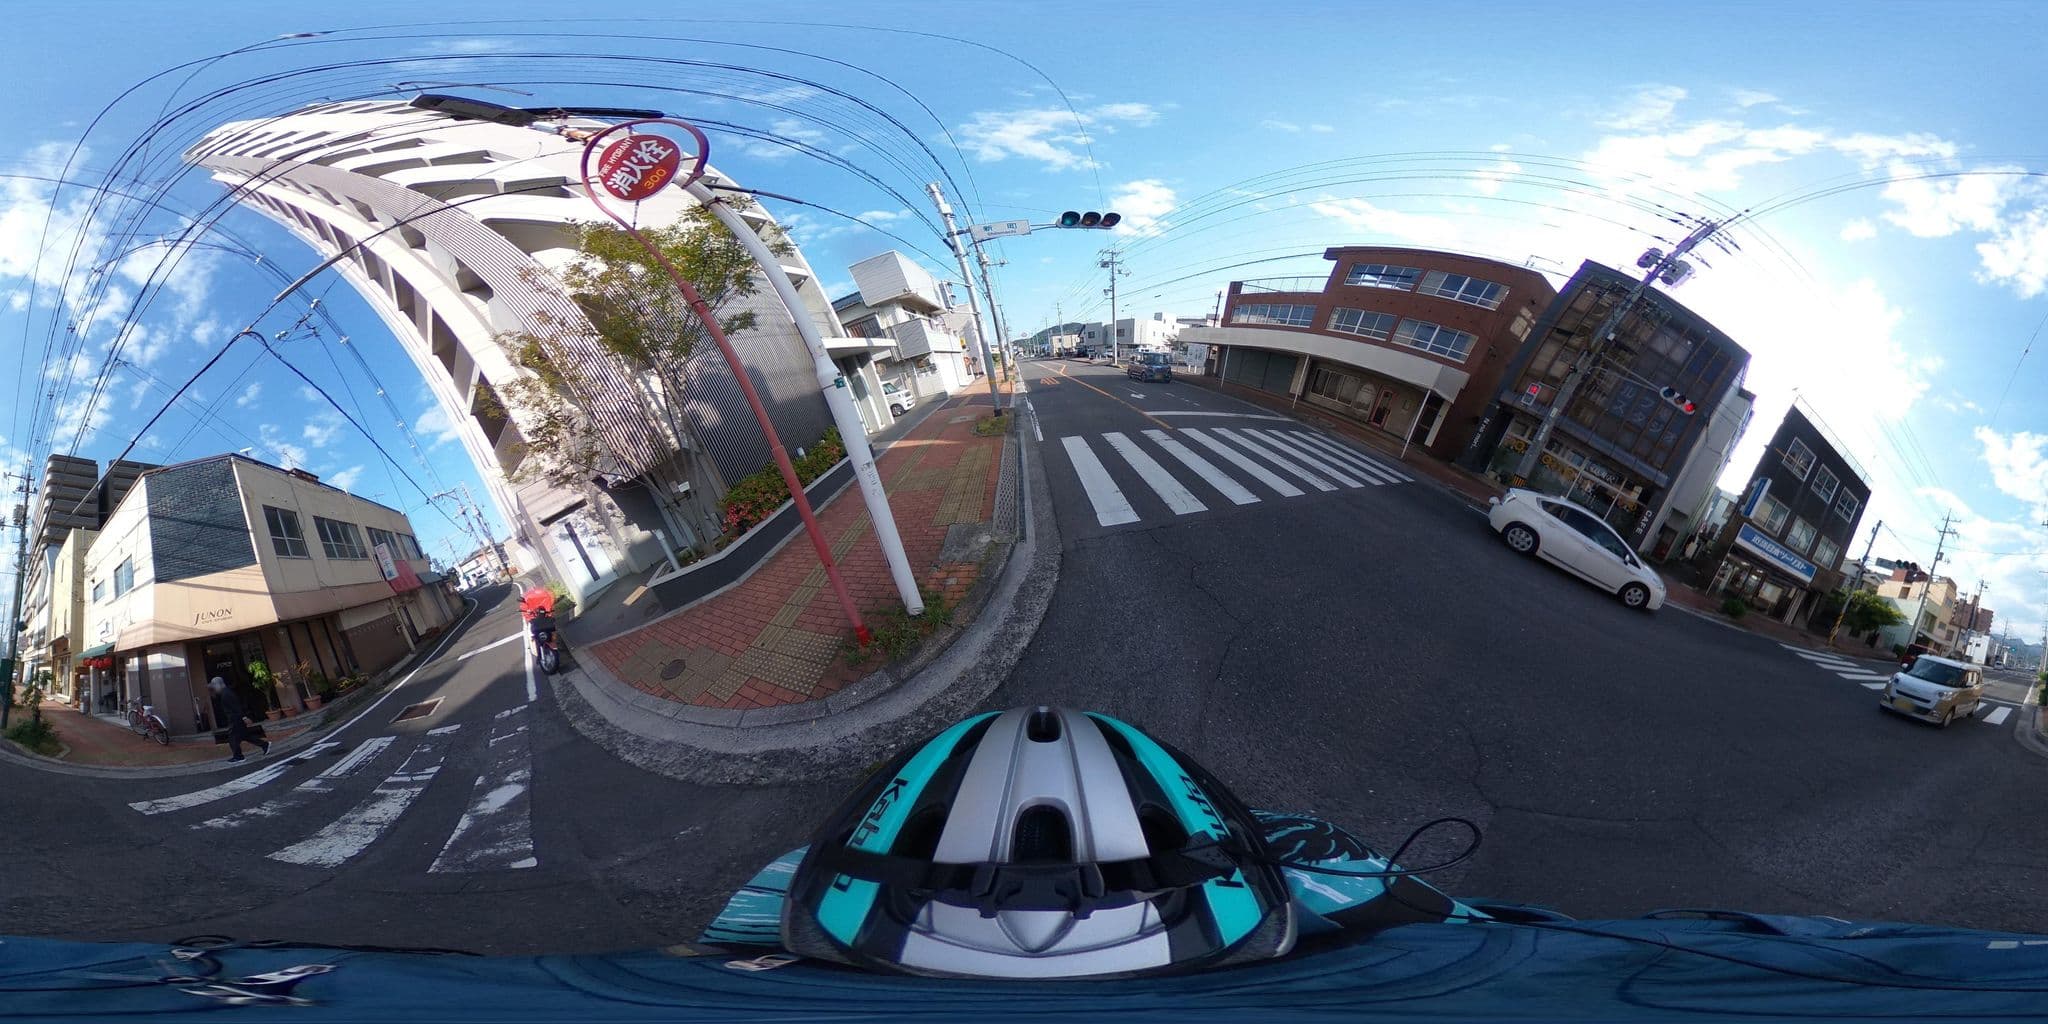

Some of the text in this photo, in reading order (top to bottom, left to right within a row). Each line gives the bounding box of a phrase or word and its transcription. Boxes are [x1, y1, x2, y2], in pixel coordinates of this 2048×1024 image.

[599, 137, 634, 178] FIRE HYDRANT
[606, 140, 674, 197] 消火栓
[643, 168, 667, 190] 300
[1635, 510, 1653, 535] CAFE
[194, 607, 233, 626] JUNON
